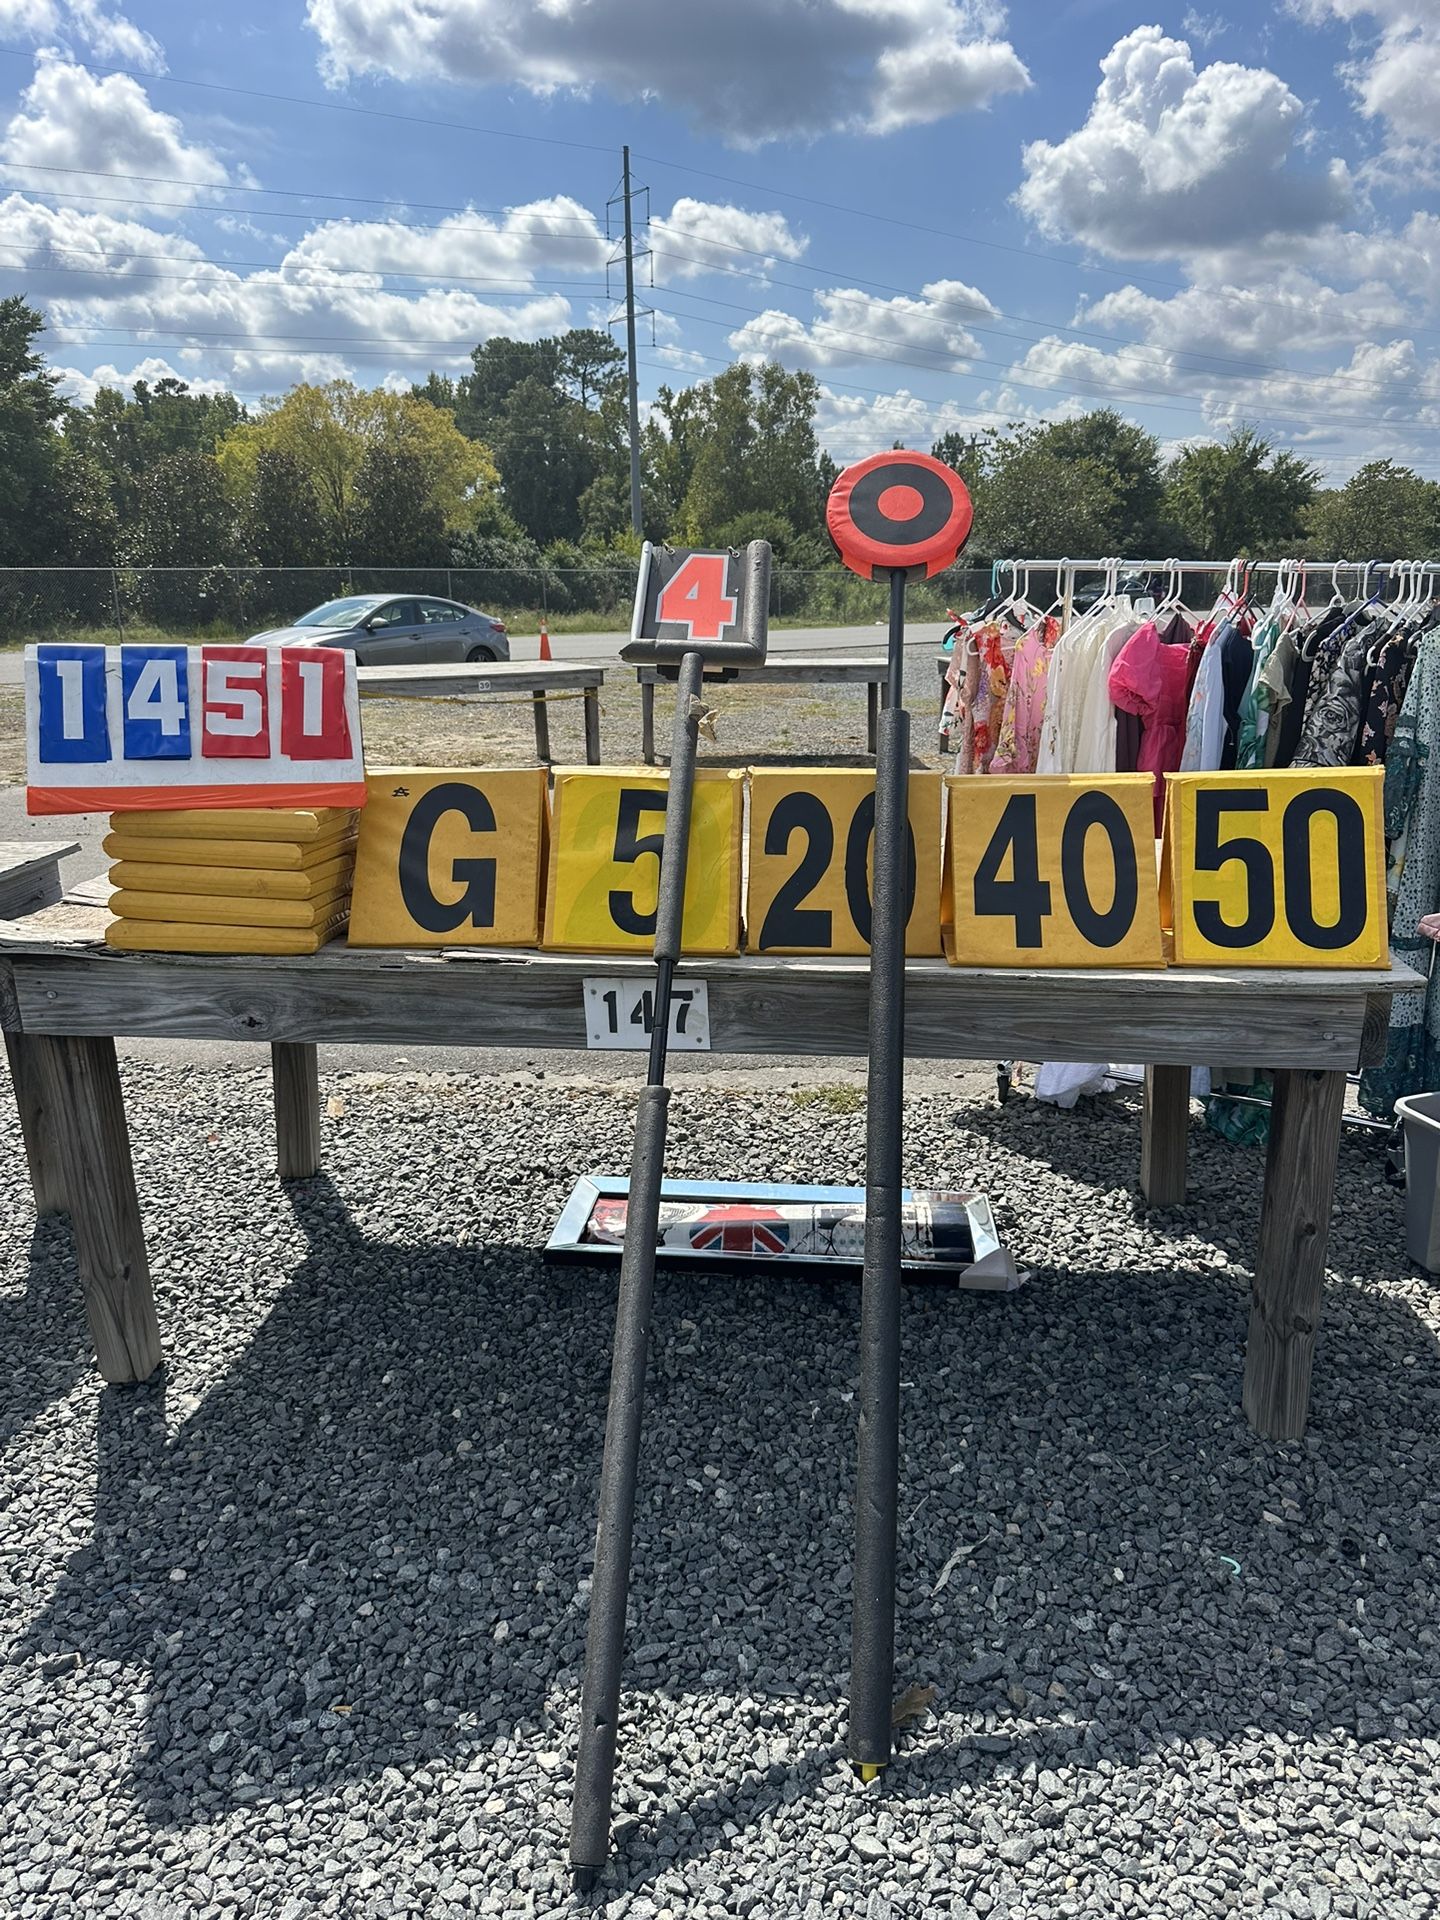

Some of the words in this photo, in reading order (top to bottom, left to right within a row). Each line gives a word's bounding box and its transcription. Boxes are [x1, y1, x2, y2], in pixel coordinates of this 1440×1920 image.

[655, 554, 738, 641] 4
[479, 682, 490, 690] 39
[399, 782, 497, 934] G
[609, 788, 671, 936] 5
[759, 791, 917, 949] 20
[973, 790, 1138, 949] 40
[1193, 788, 1368, 950] 50
[602, 990, 694, 1034] 147
